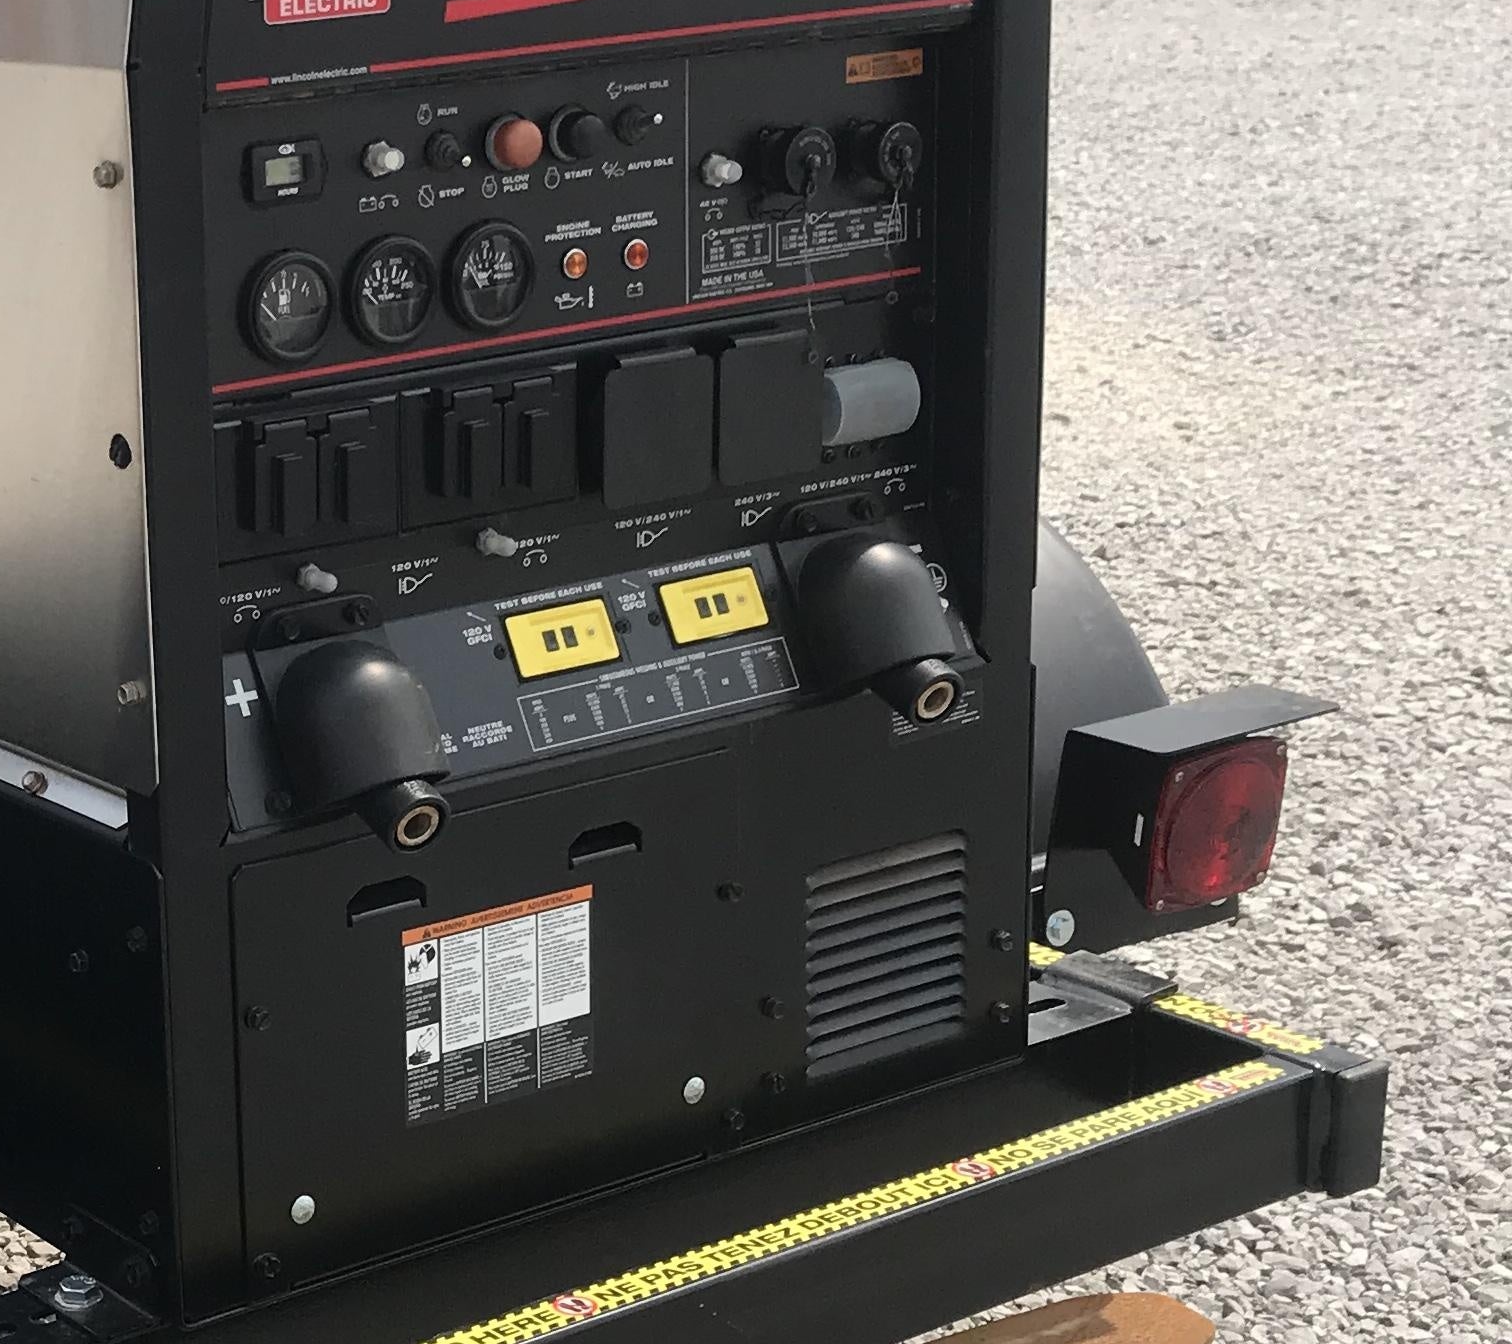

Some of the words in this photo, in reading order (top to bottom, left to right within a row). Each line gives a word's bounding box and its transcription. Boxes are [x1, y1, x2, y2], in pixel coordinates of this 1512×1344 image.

[437, 107, 458, 116] RUN
[628, 160, 651, 171] AUTO
[653, 157, 674, 167] IDLE
[502, 174, 530, 184] GLOW
[564, 168, 593, 180] START
[439, 187, 465, 198] STOP
[503, 182, 529, 193] PLUG
[615, 211, 654, 223] BATTERY
[556, 220, 591, 233] ENGINE
[611, 218, 658, 232] CHARGING
[545, 227, 602, 242] PROTECTION
[702, 275, 723, 287] MADE
[748, 269, 764, 279] USA
[391, 561, 414, 572] 120
[647, 567, 670, 578] TEST
[671, 559, 707, 574] BEFORE
[708, 554, 732, 566] EACH
[733, 549, 752, 560] USE
[494, 600, 519, 611] TEST
[520, 592, 556, 606] BEFORE
[557, 586, 582, 598] EACH
[583, 581, 603, 593] USE
[617, 594, 637, 605] 120
[638, 590, 646, 600] V
[622, 599, 647, 612] GFCI
[462, 626, 483, 638] 120
[484, 625, 492, 633] V
[466, 633, 493, 646] GFCI
[462, 725, 513, 743] RACCORDE
[468, 720, 503, 734] NEUTRE
[472, 739, 485, 748] AU
[487, 734, 508, 745] BATI
[988, 1148, 1033, 1167] NO
[1031, 1134, 1072, 1152] SE
[1068, 1111, 1141, 1139] PARE
[594, 1281, 643, 1302] NE
[640, 1260, 705, 1285] PAS
[701, 1227, 803, 1264] TENEZ
[799, 1189, 914, 1230] DEBOUT
[912, 1173, 959, 1192] ICI
[470, 1309, 562, 1344] HERE
